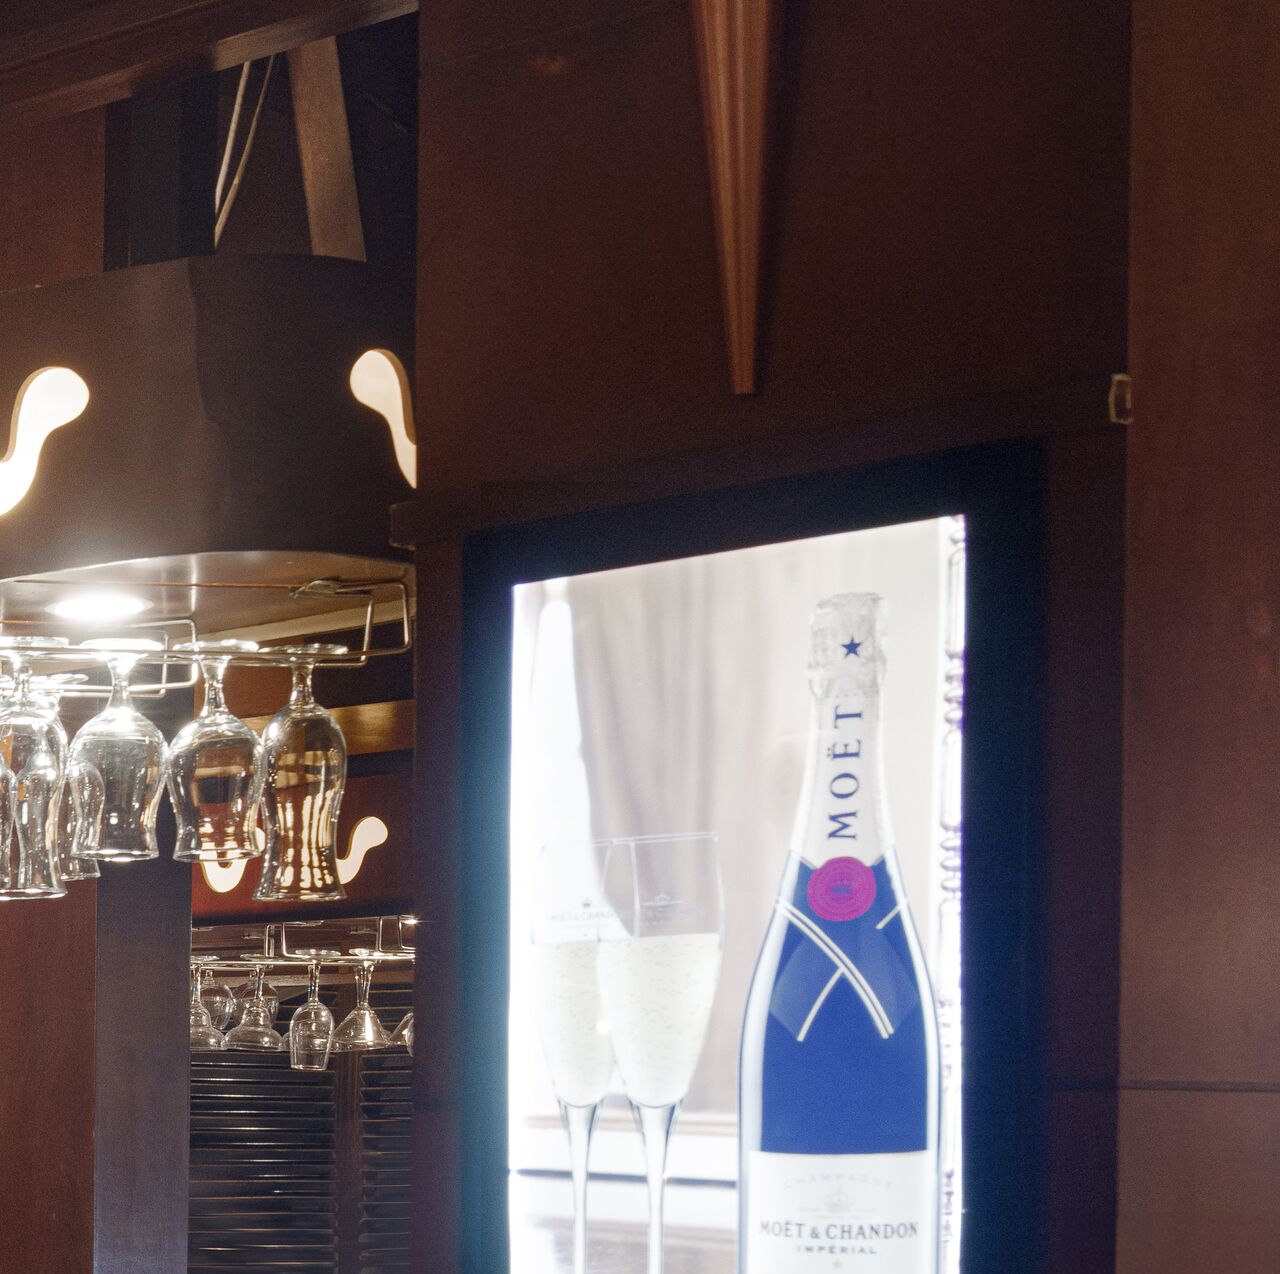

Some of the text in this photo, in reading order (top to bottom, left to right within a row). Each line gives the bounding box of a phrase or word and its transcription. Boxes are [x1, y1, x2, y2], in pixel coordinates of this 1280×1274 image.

[826, 704, 864, 840] MOËT
[760, 1219, 919, 1240] MOËT & CHANDON
